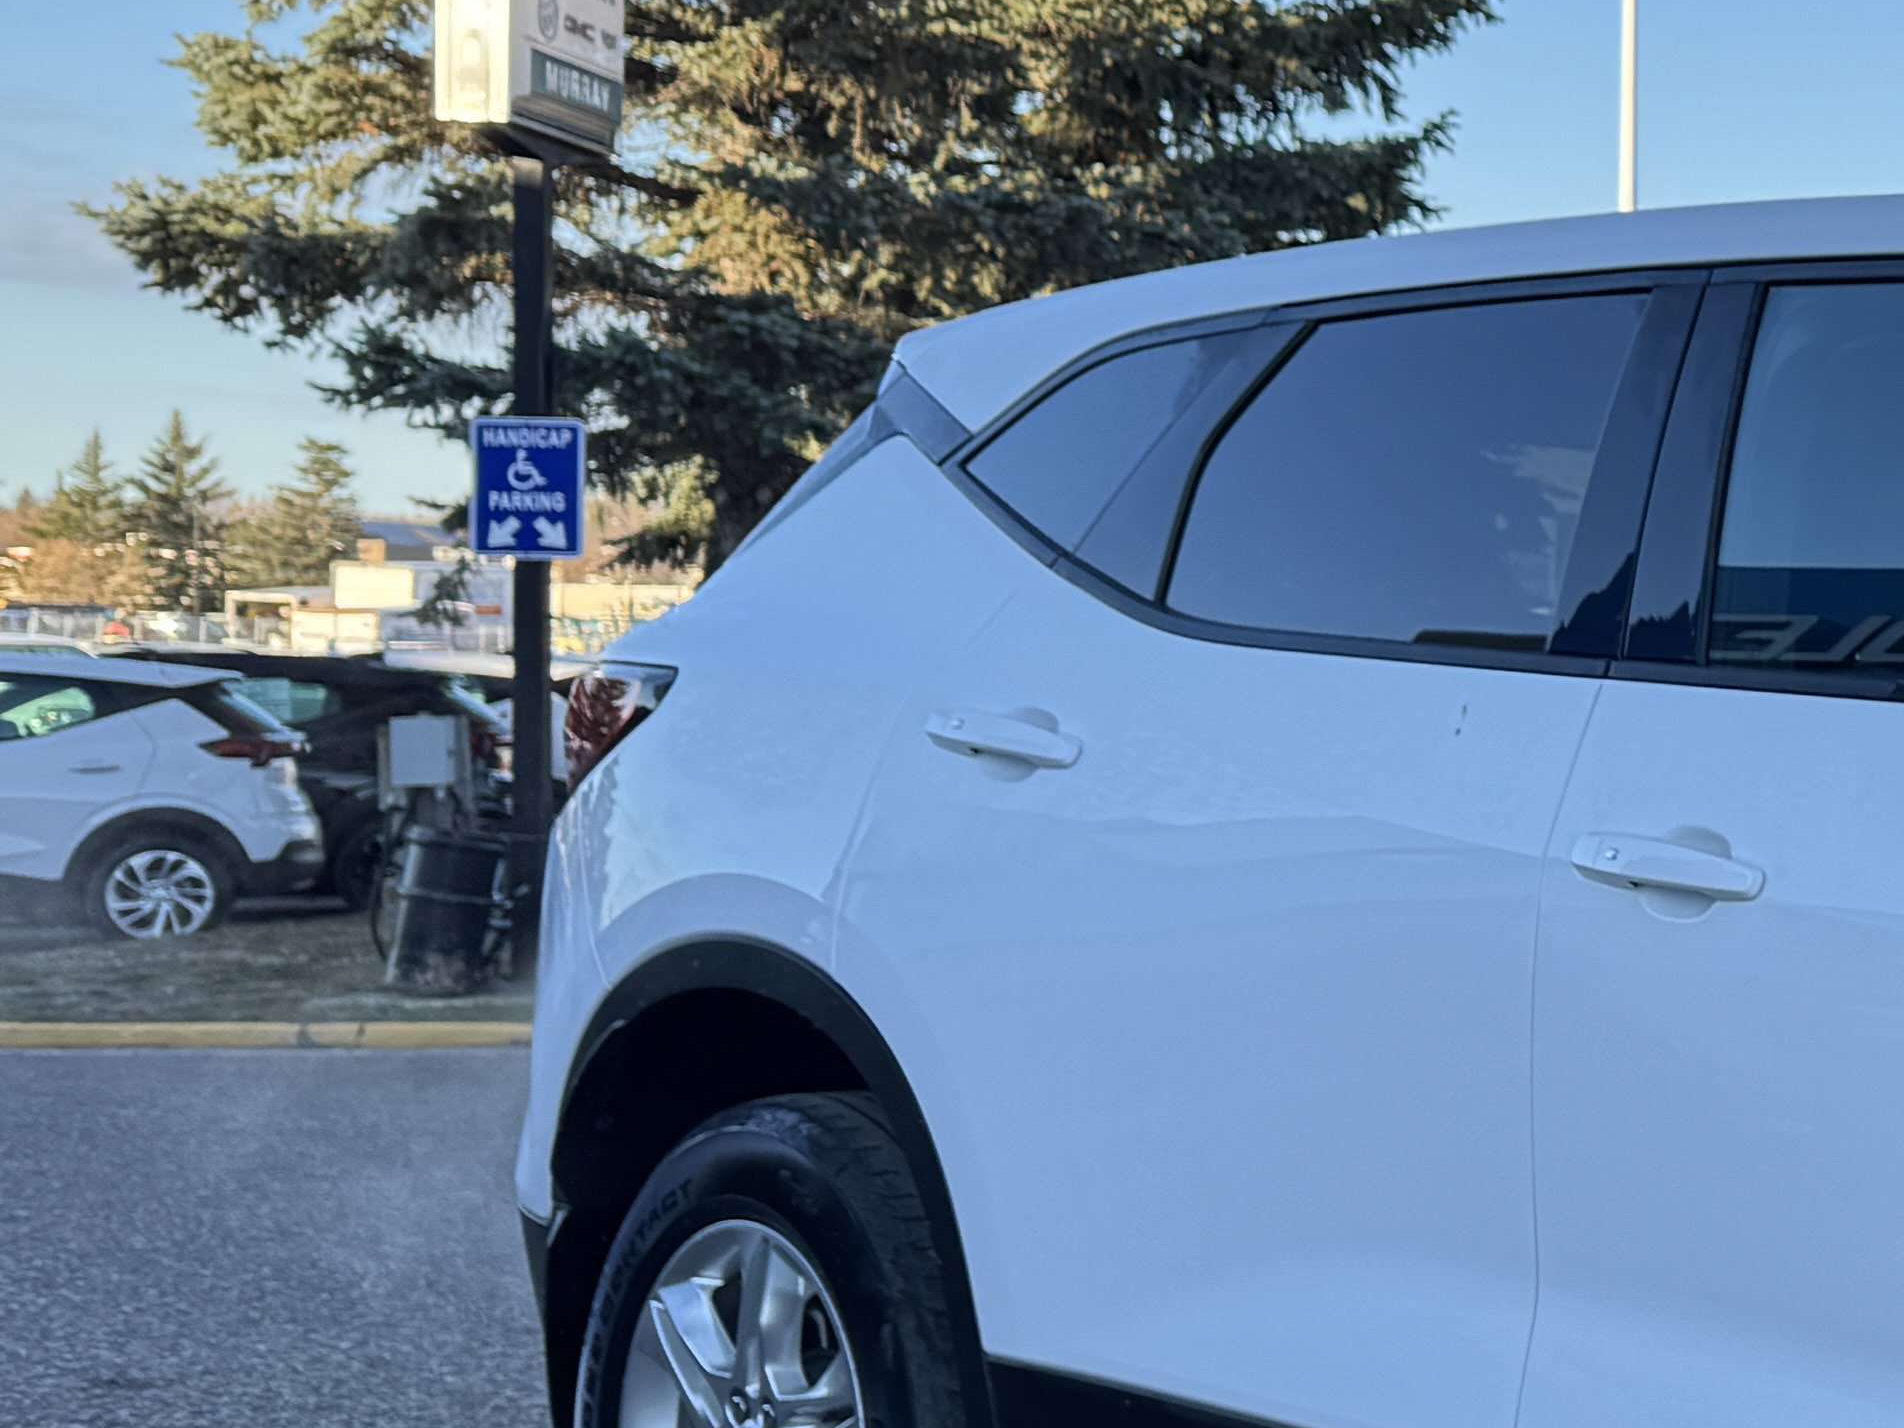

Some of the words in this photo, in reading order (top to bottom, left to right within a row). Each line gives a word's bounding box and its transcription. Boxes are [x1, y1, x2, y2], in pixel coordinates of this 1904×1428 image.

[545, 60, 611, 112] MURRAY
[482, 427, 573, 449] HANDICAP
[488, 490, 567, 513] PARKING
